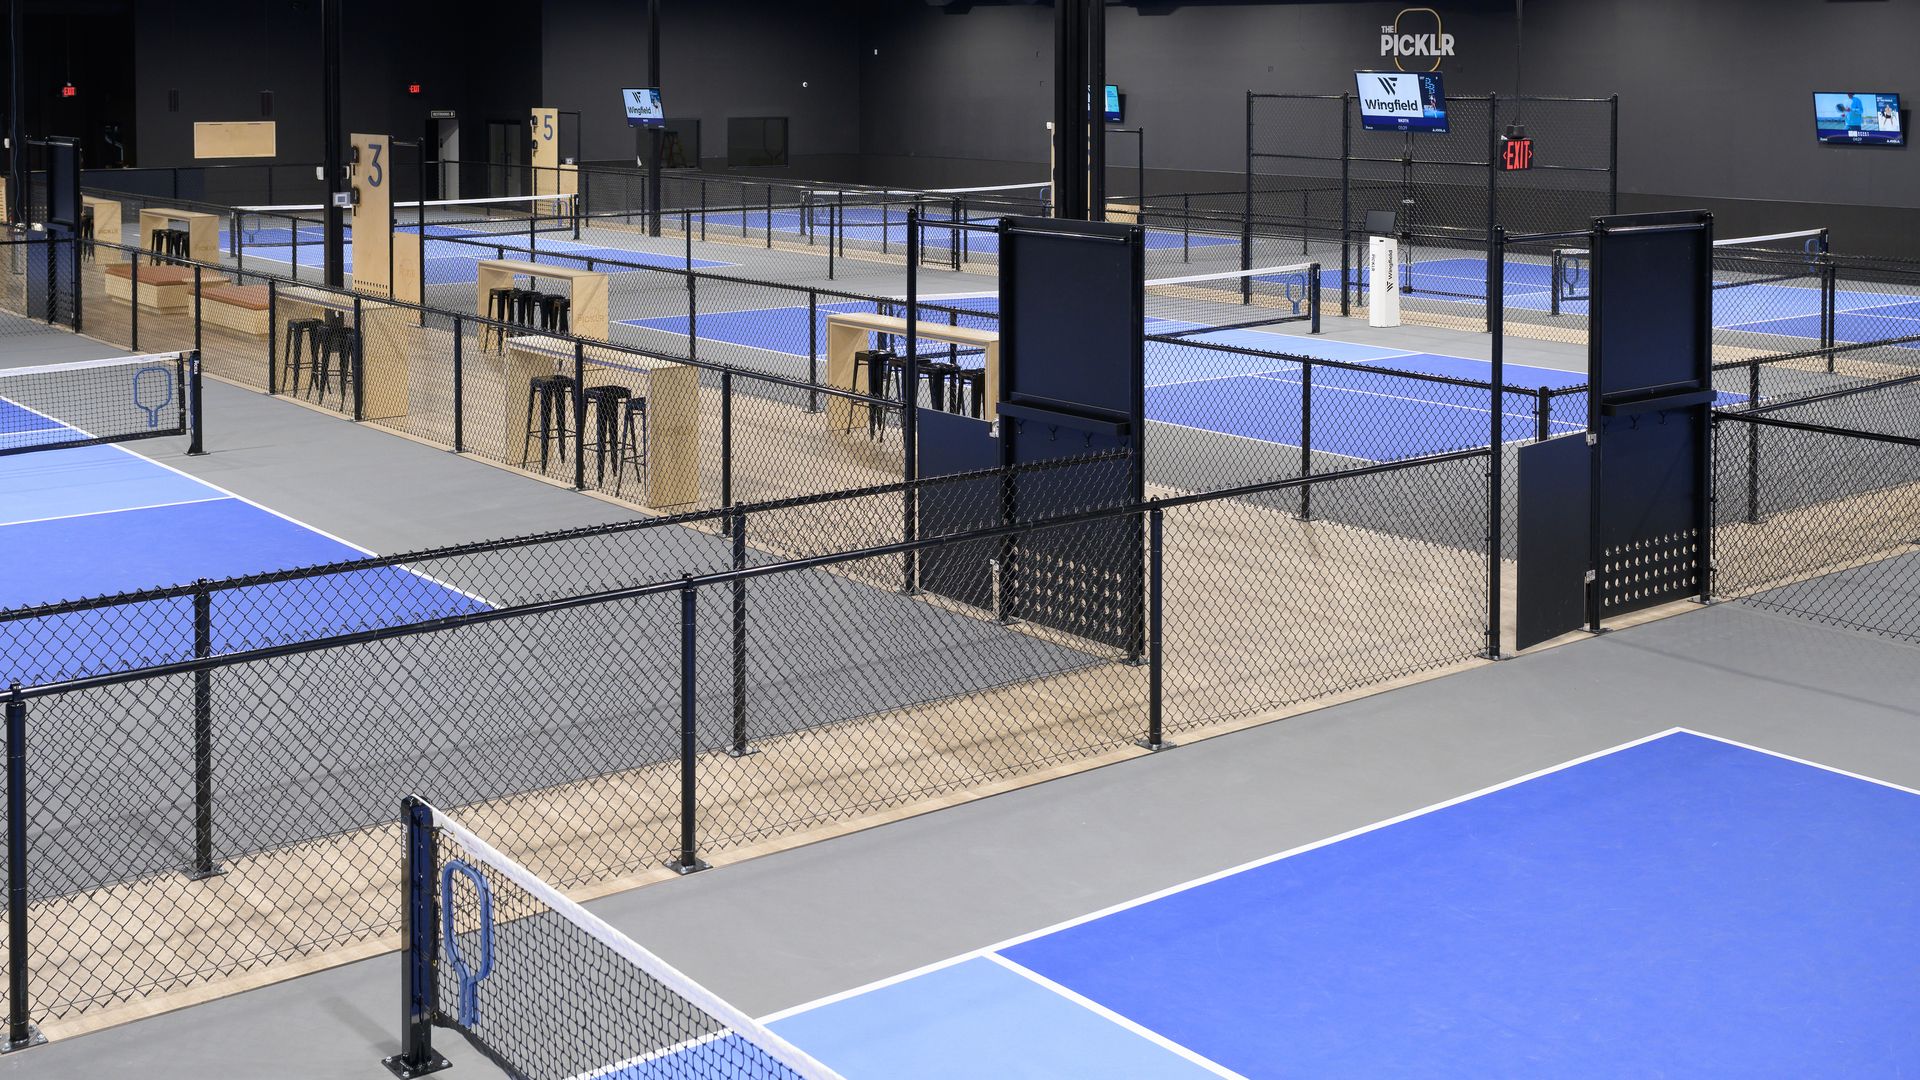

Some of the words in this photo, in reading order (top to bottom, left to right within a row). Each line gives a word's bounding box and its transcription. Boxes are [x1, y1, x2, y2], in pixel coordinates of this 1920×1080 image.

[1381, 25, 1394, 33] THE
[1380, 33, 1455, 56] PICKLR
[628, 106, 652, 116] Wingfield
[1365, 98, 1419, 113] Wingfield
[543, 115, 554, 141] 5
[367, 143, 383, 187] 3
[1506, 140, 1530, 170] EXIT
